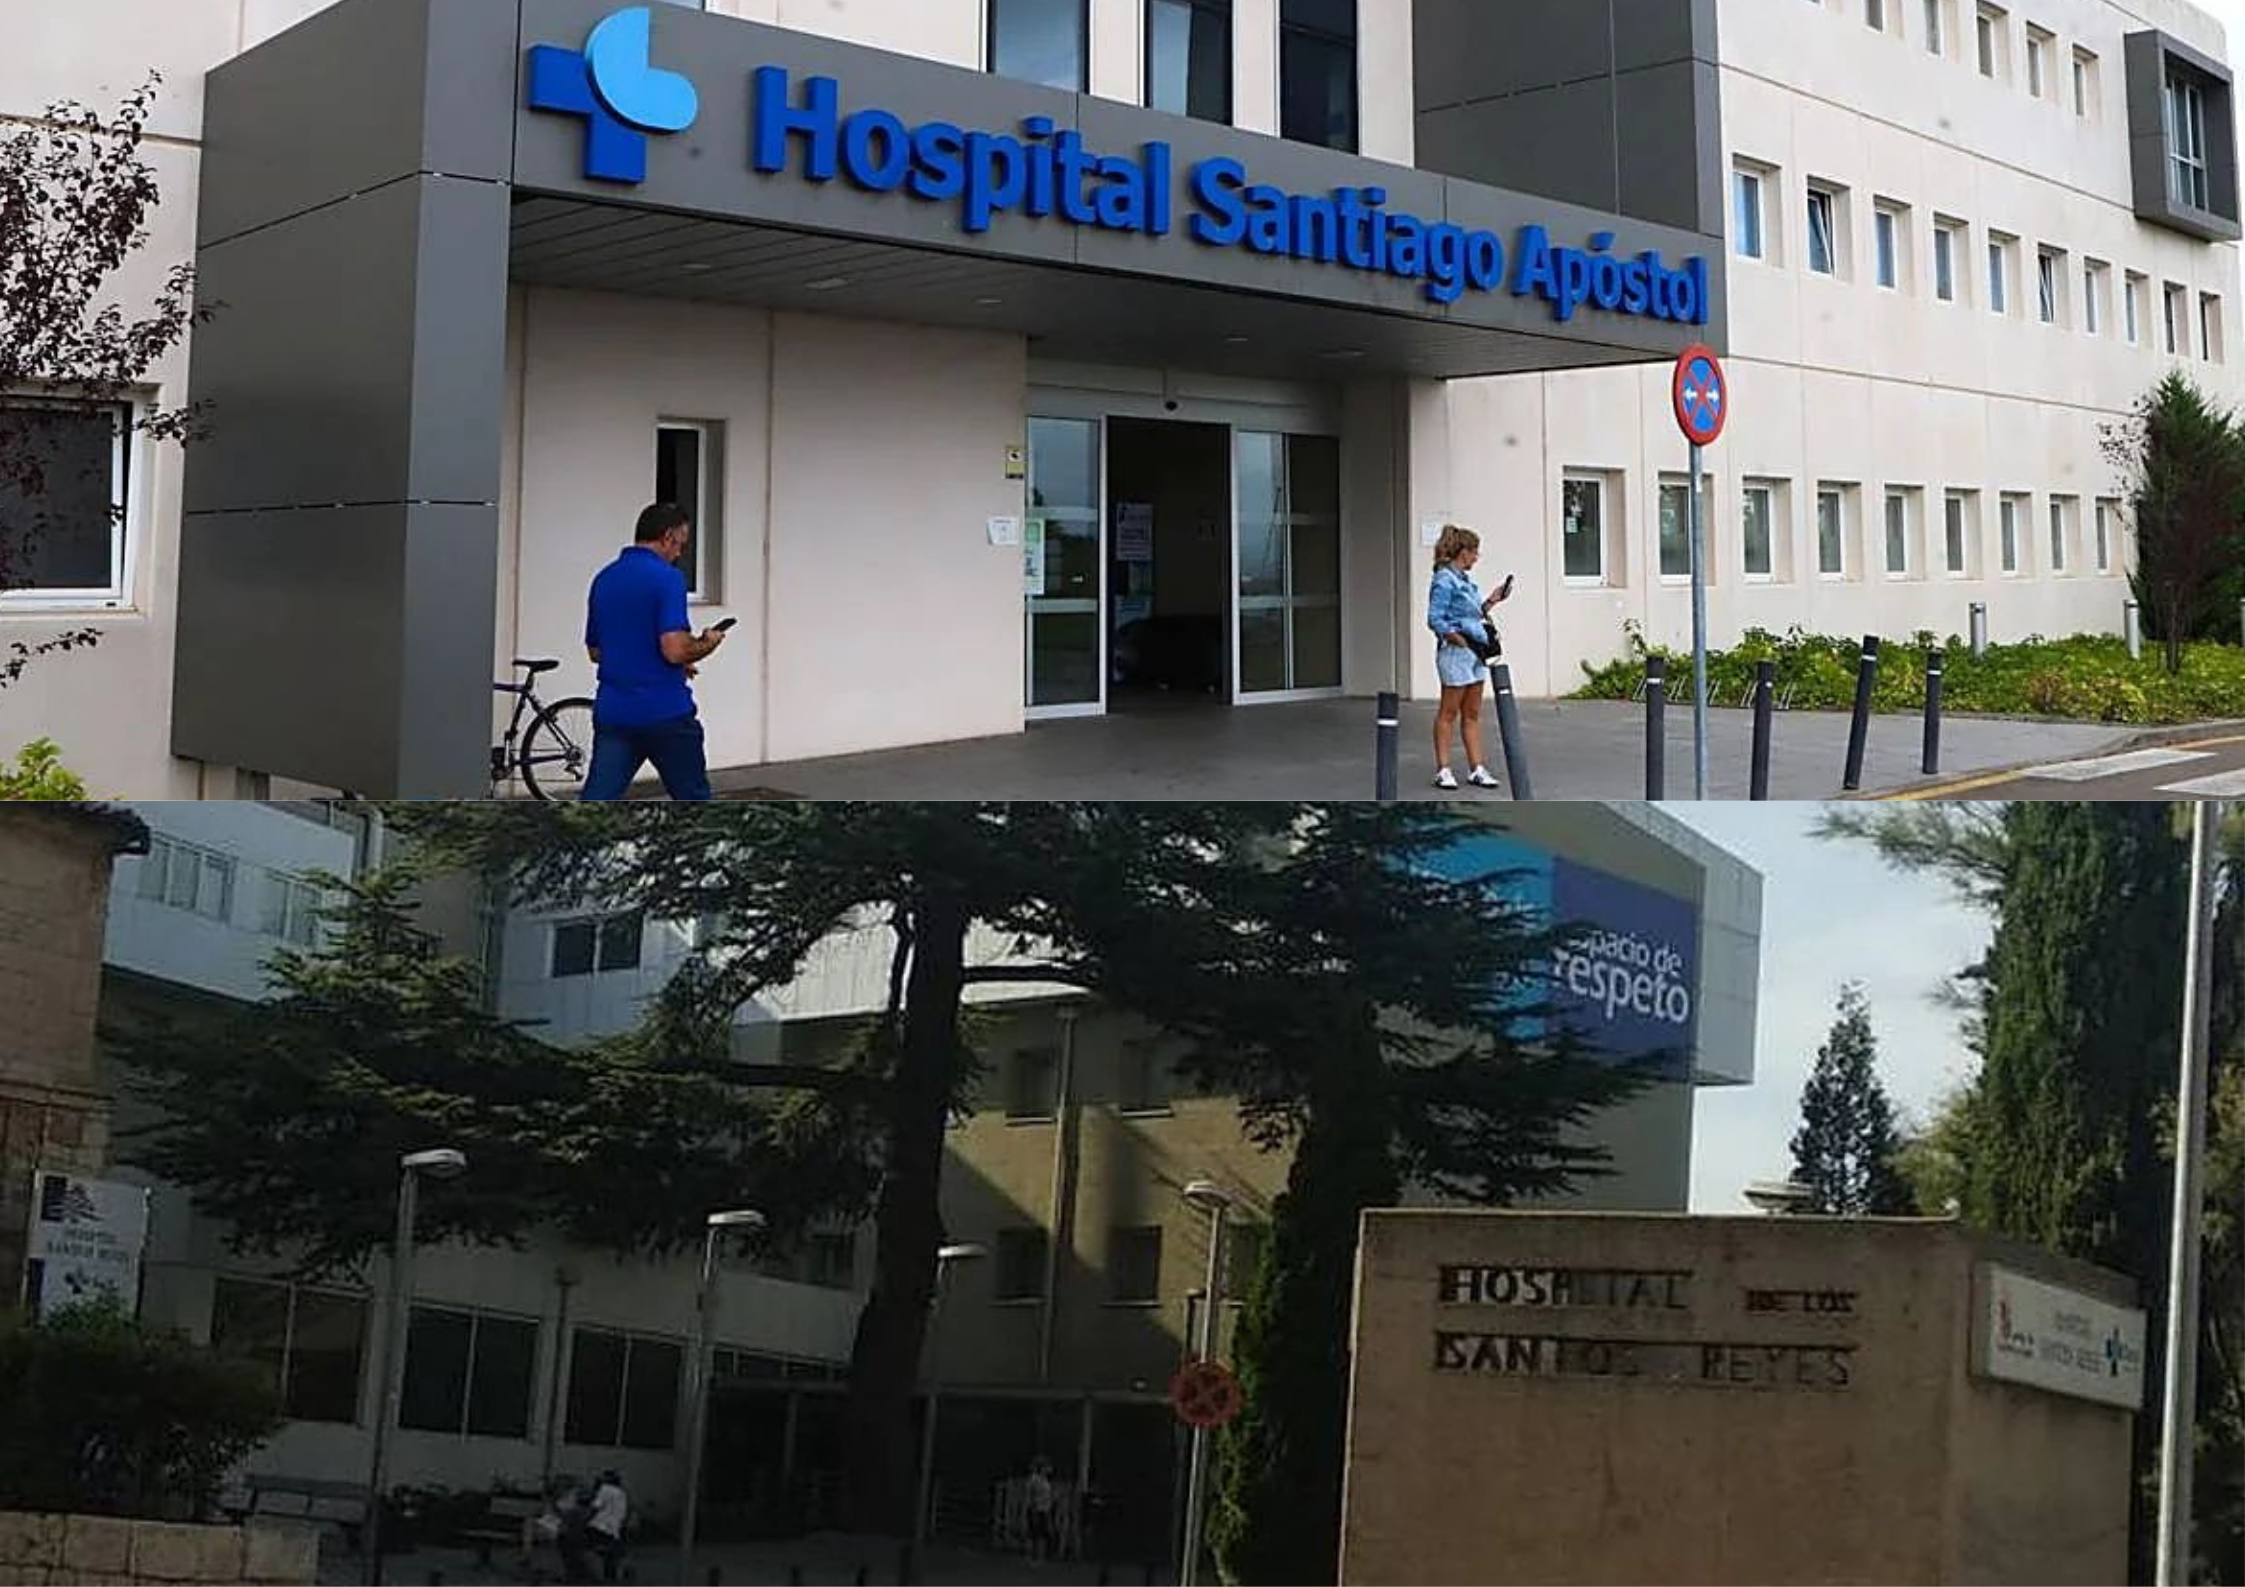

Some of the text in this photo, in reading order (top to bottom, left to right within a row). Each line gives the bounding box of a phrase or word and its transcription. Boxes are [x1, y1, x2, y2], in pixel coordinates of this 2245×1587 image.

[752, 65, 1709, 325] Hospital Santiago Apóstol
[1653, 943, 1682, 978] de
